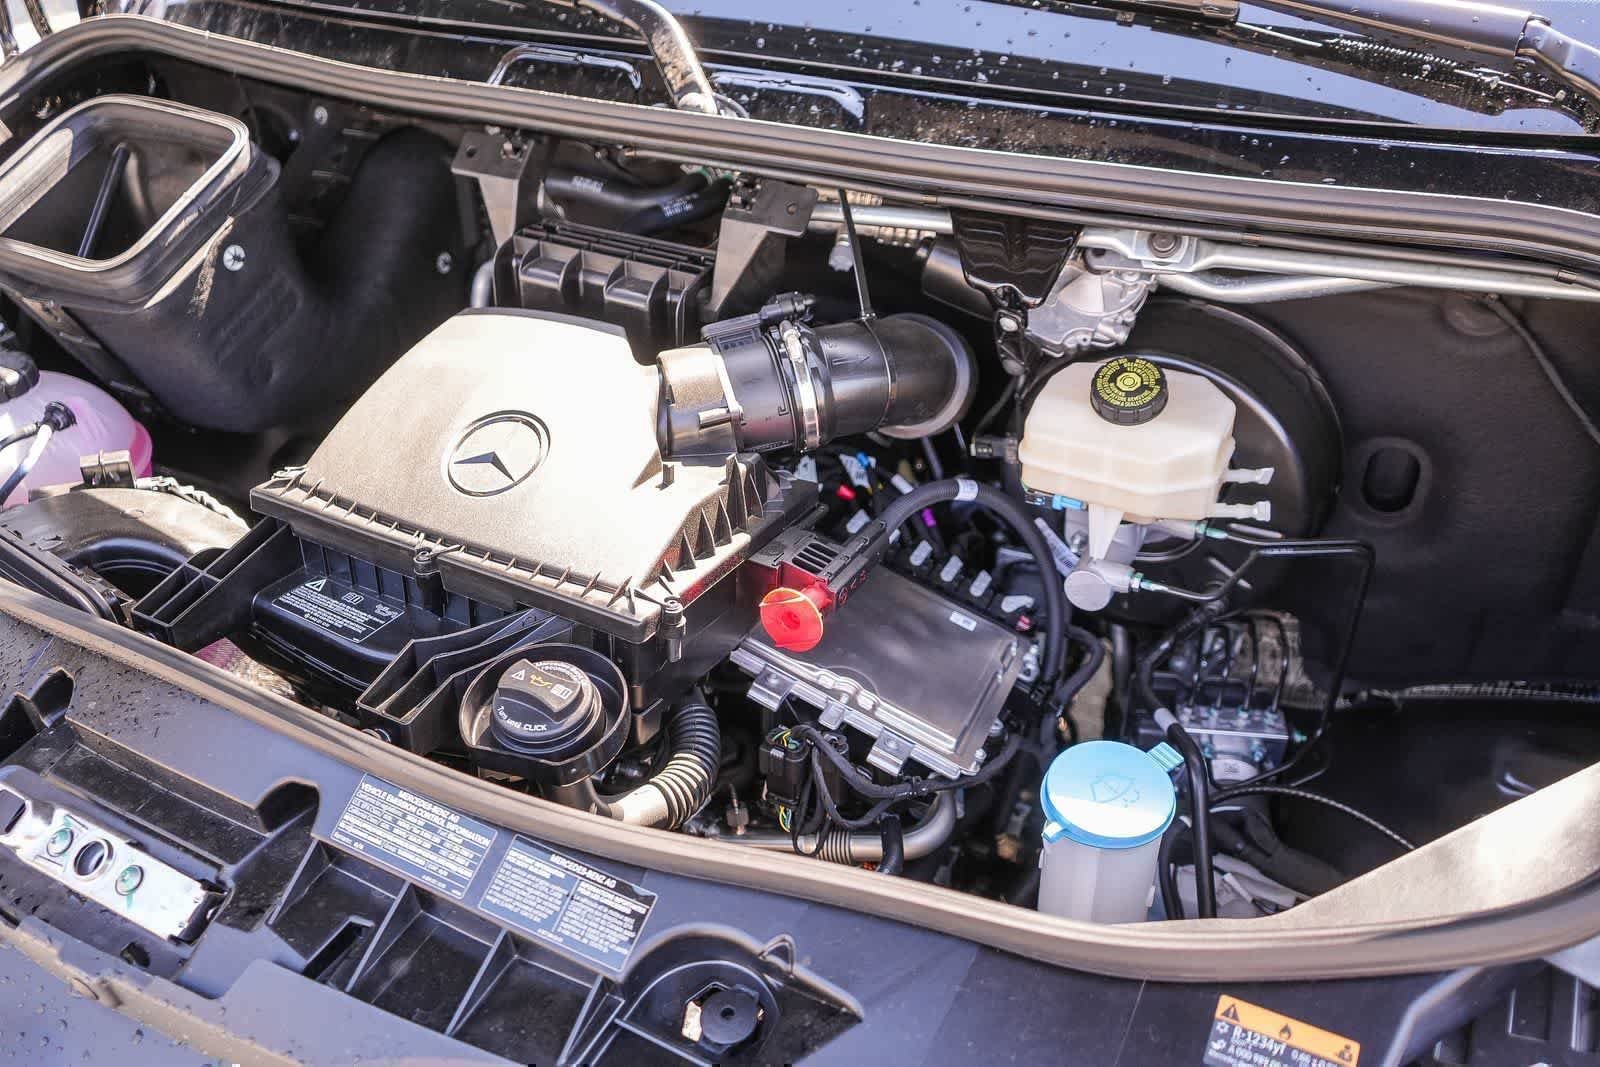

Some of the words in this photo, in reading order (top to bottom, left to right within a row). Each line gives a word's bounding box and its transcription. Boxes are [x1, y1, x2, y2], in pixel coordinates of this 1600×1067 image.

[523, 723, 548, 732] CLICK
[361, 782, 388, 800] VEHICLE
[386, 793, 417, 814] EMISSION
[416, 808, 446, 827] CONTROL
[446, 820, 492, 846] INFORMATION
[398, 790, 450, 820] MERCEDES-BENZ
[550, 853, 606, 884] MERCEDES-BENZ
[1232, 1025, 1287, 1056] R-1234yf
